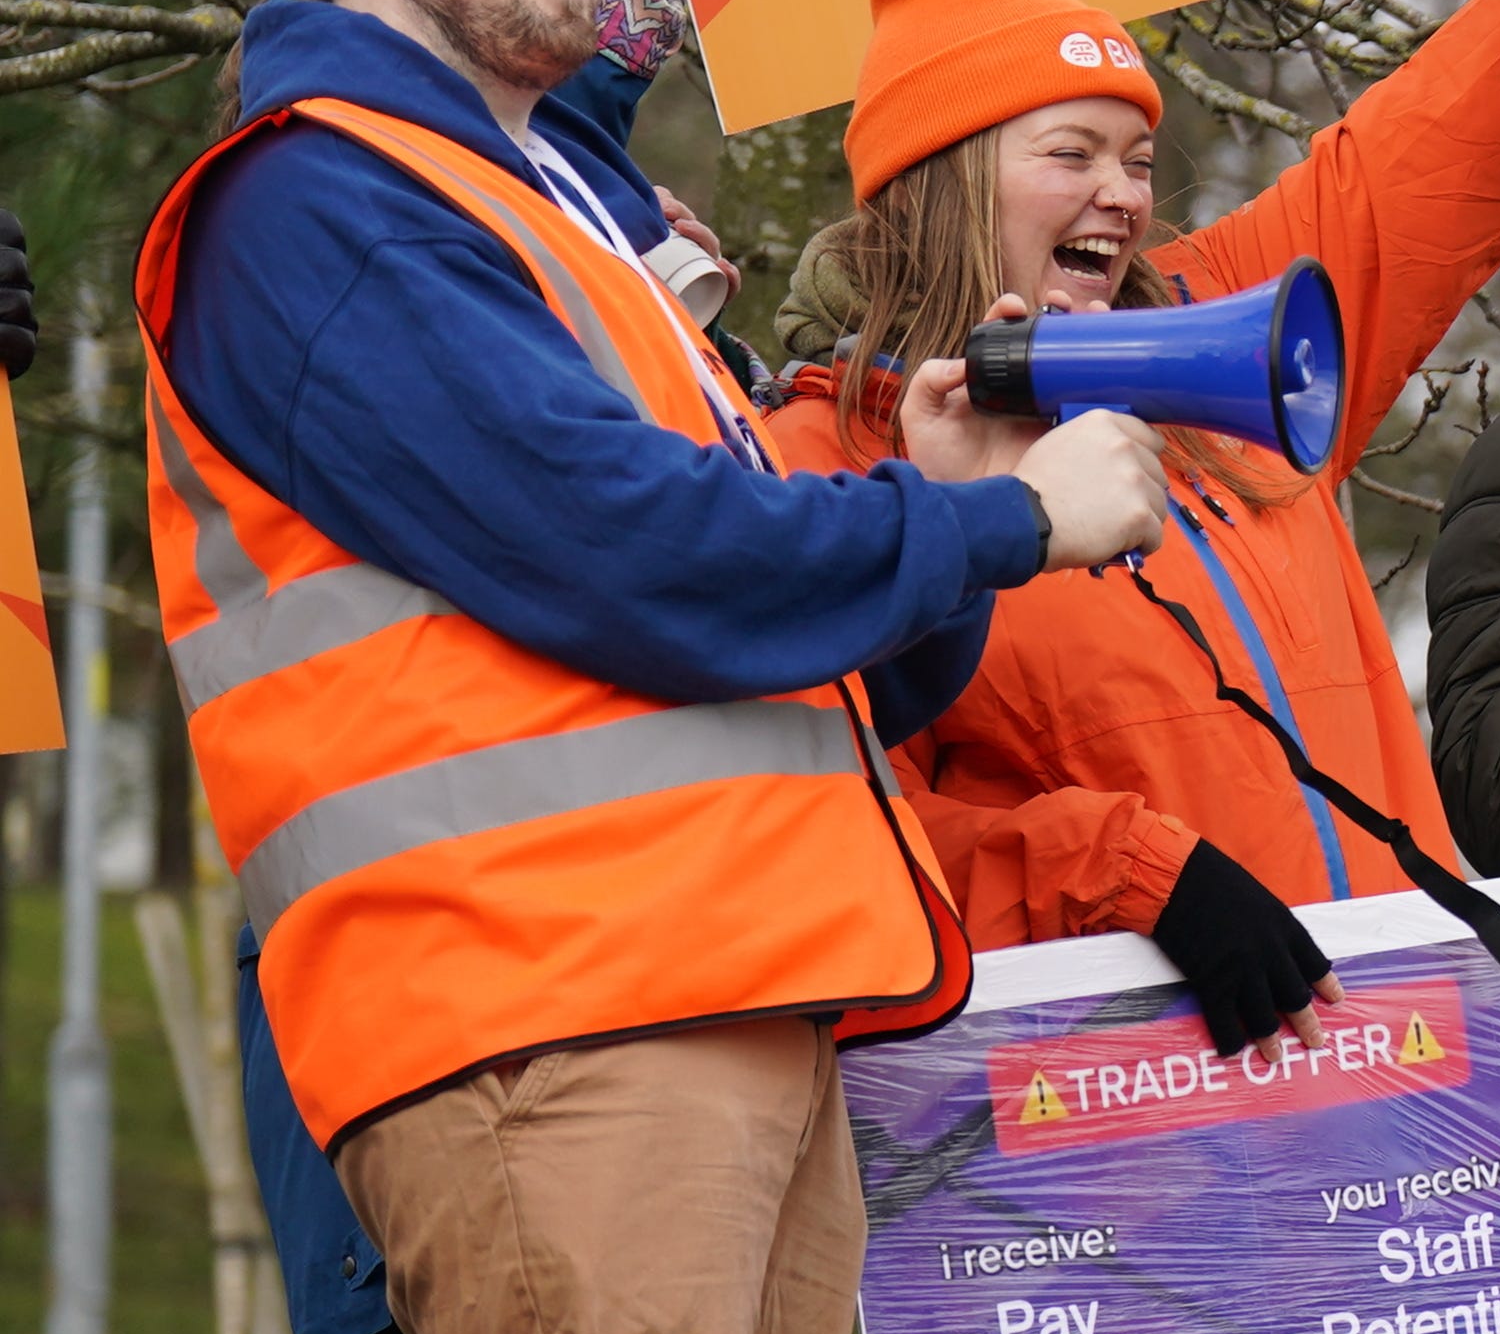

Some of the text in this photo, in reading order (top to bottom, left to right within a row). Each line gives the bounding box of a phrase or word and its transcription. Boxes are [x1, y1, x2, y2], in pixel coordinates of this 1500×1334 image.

[1067, 1024, 1394, 1114] TRADE OFFER
[1322, 1176, 1387, 1222] you
[942, 1224, 1117, 1280] i receive:
[1378, 1212, 1495, 1283] Staff
